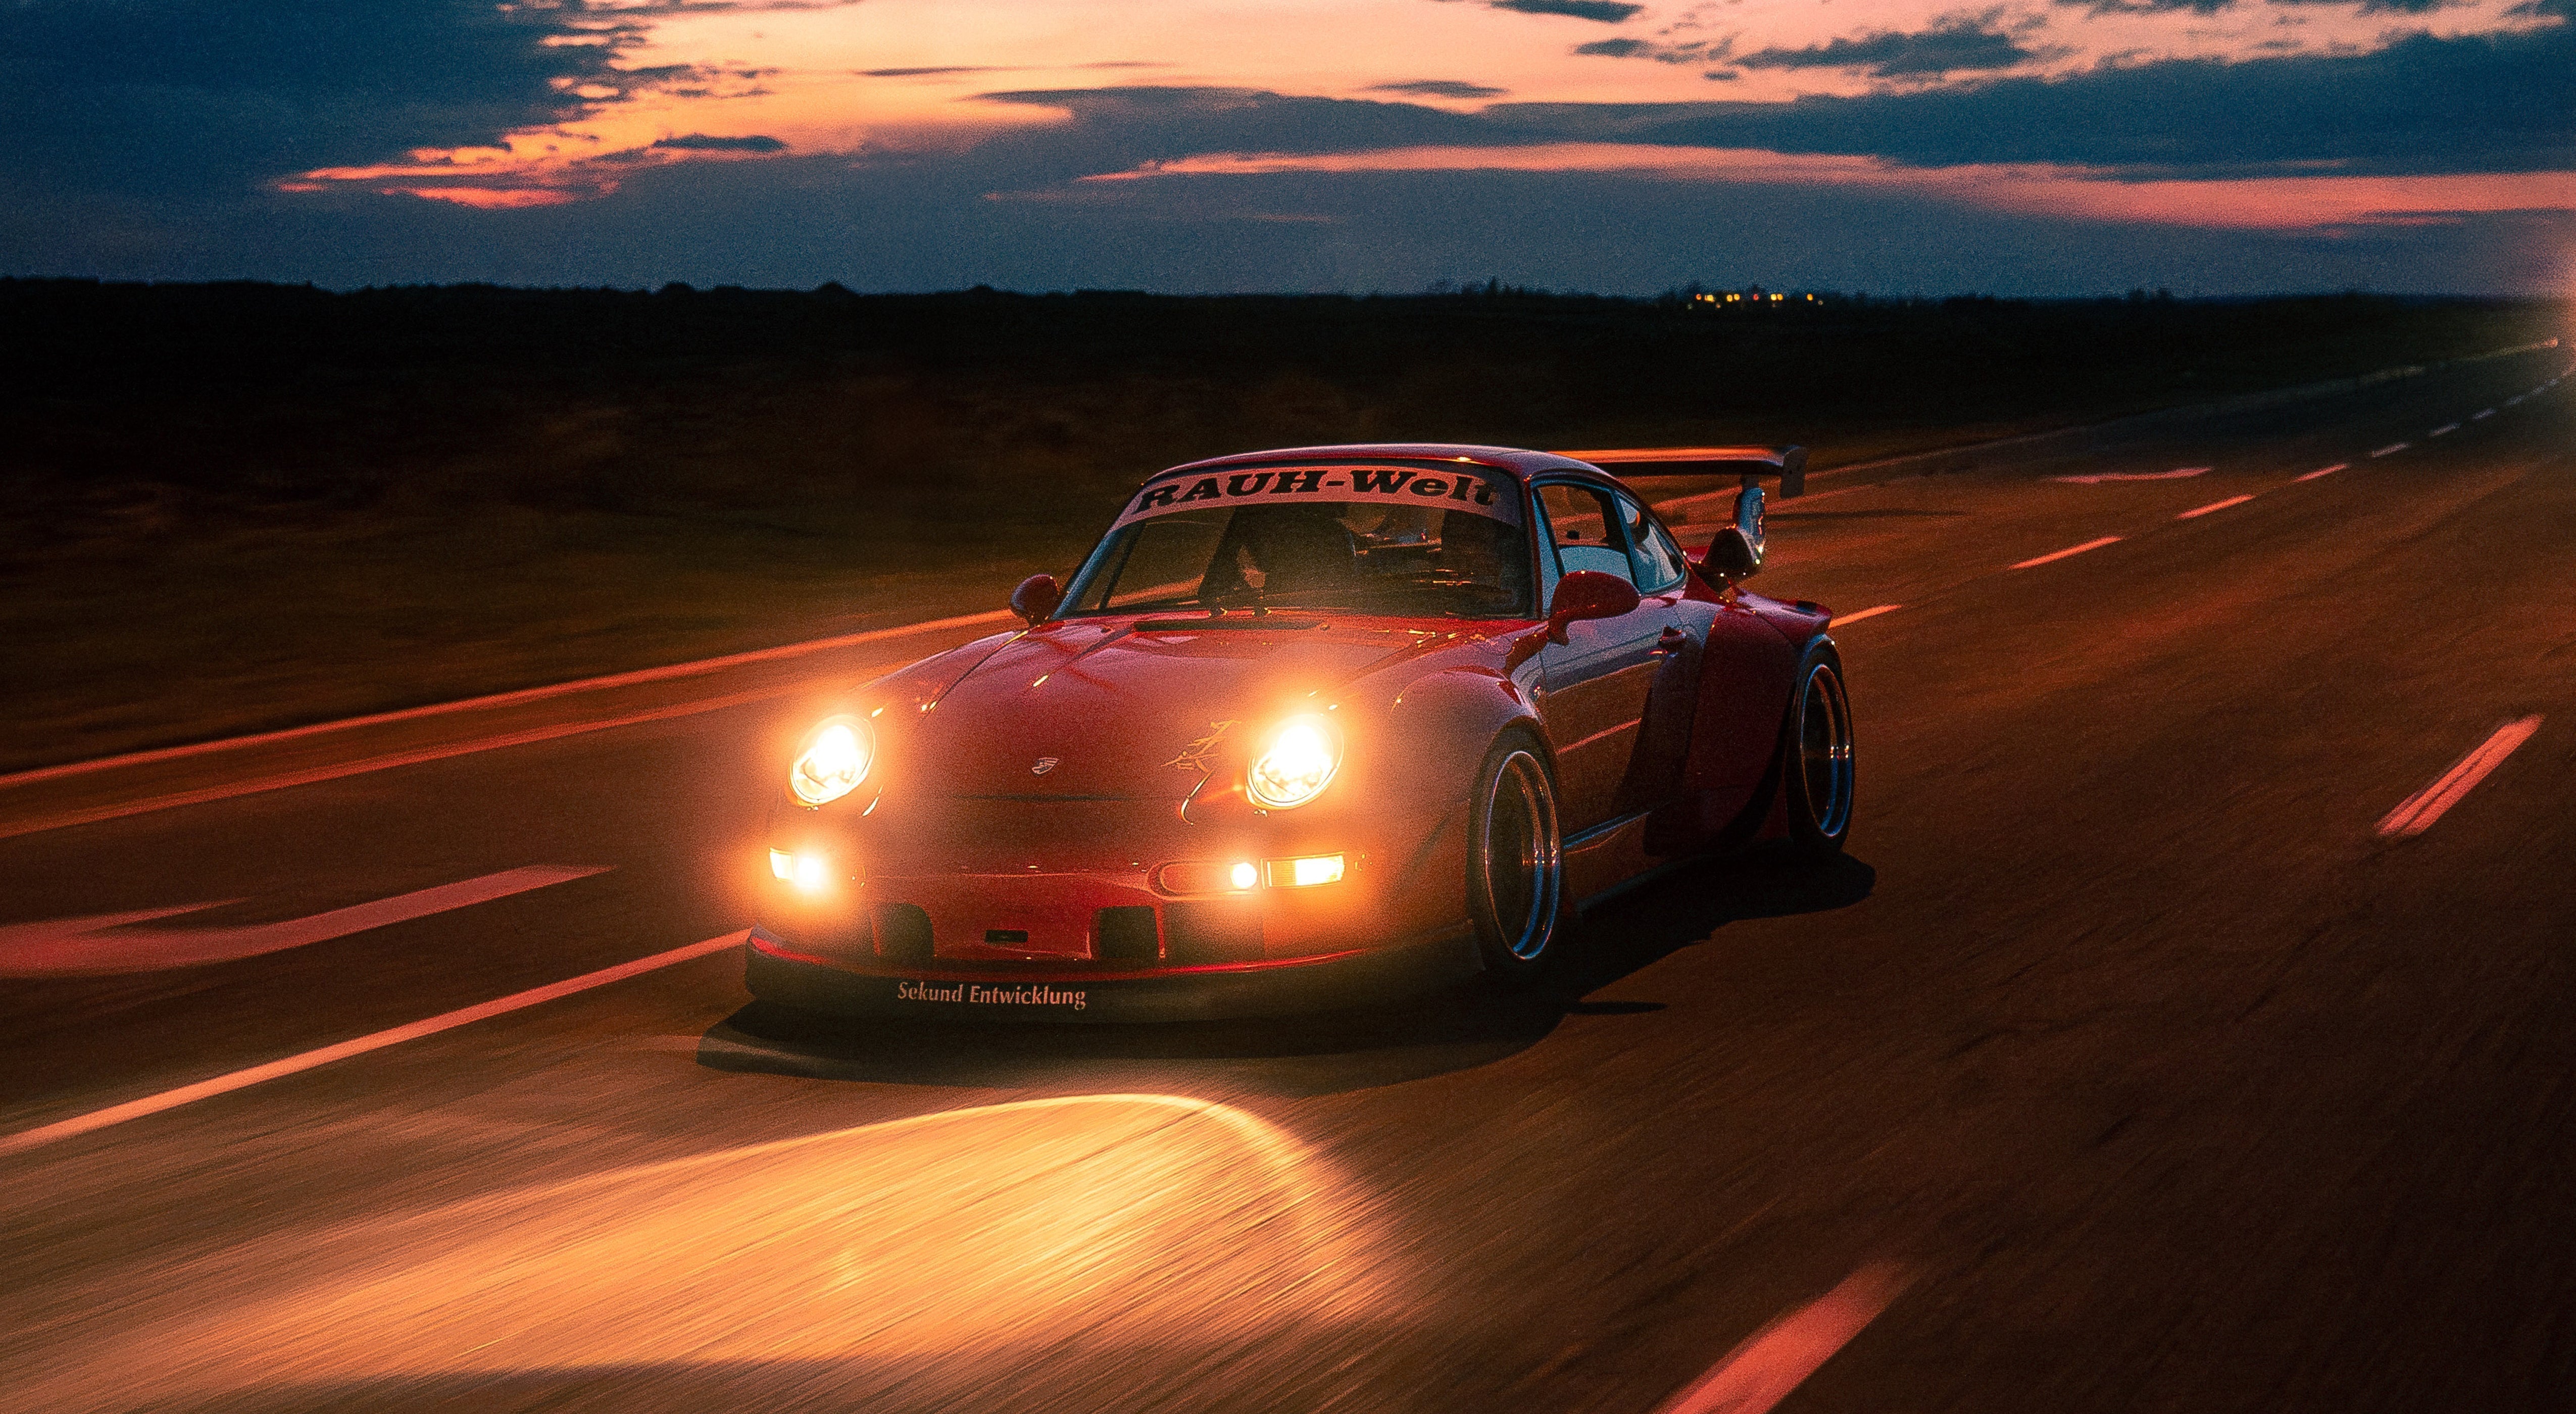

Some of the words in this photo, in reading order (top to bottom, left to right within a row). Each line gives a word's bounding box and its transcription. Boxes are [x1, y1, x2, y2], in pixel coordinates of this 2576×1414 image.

[1131, 470, 1497, 514] RAUH-Welt
[897, 981, 963, 1002] Sekund
[969, 985, 1086, 1010] Entwicklung
